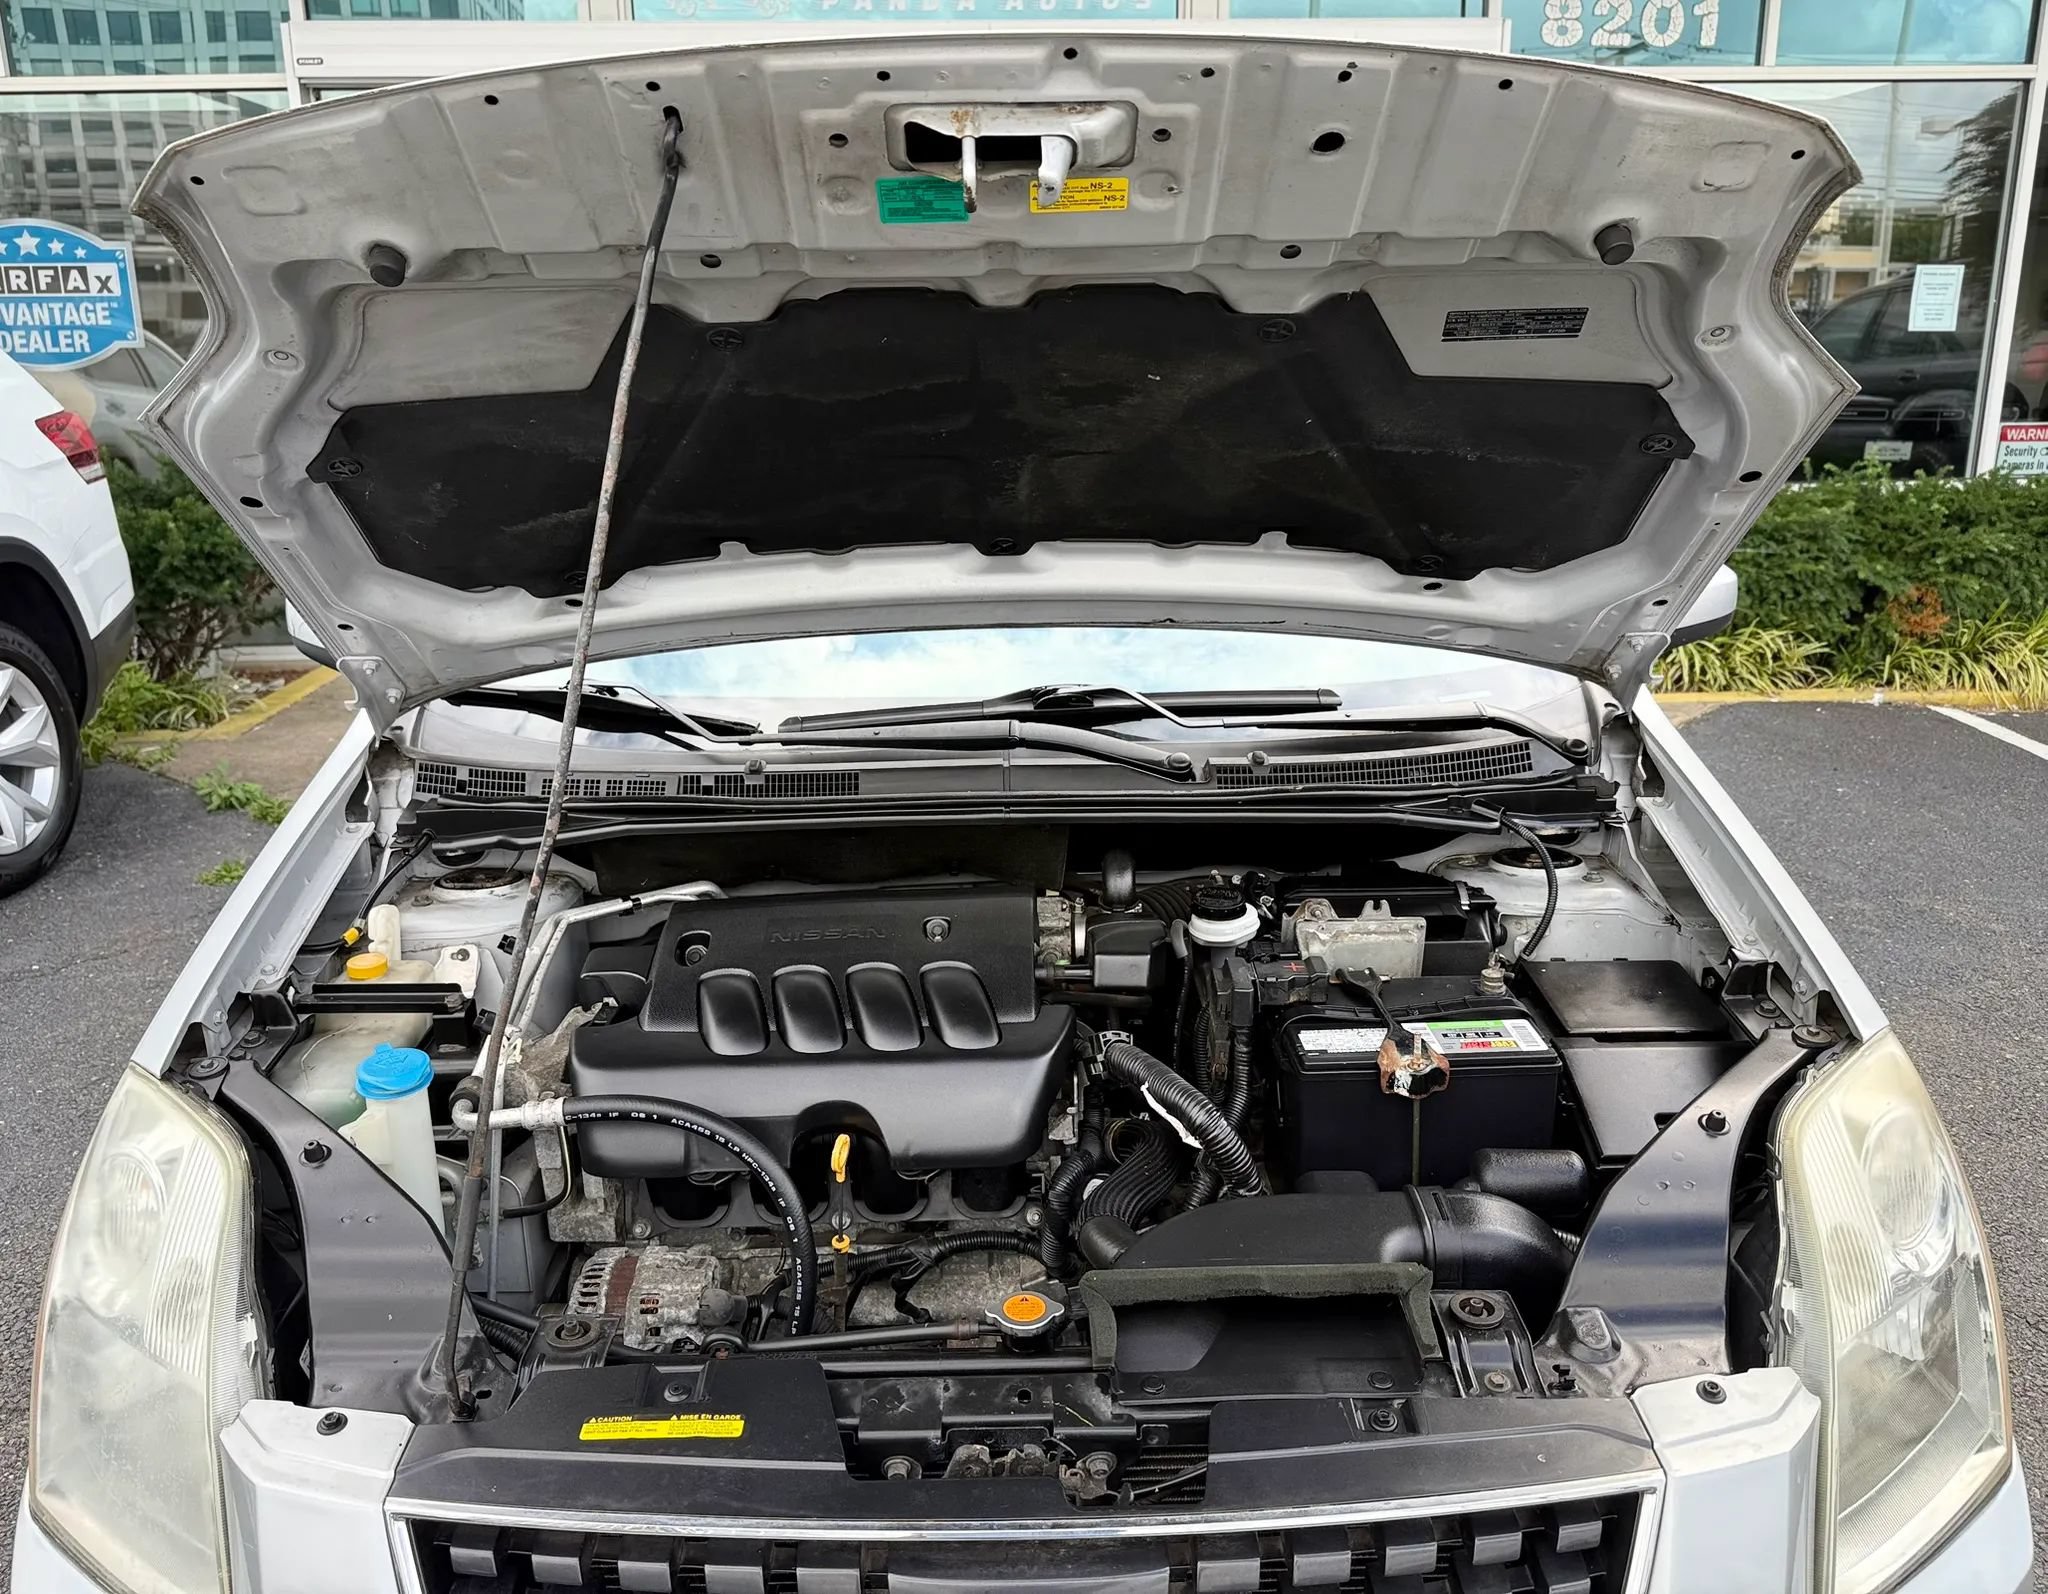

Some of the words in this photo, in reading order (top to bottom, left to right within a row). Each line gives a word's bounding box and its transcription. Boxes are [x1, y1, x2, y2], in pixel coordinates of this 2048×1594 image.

[1541, 0, 1719, 47] 8201
[0, 269, 114, 294] RFAX
[2007, 428, 2048, 441] WARNI
[2004, 445, 2038, 459] Security
[769, 926, 887, 942] NISSAN
[565, 1112, 602, 1121] C-134a
[598, 1416, 633, 1424] CAUTION
